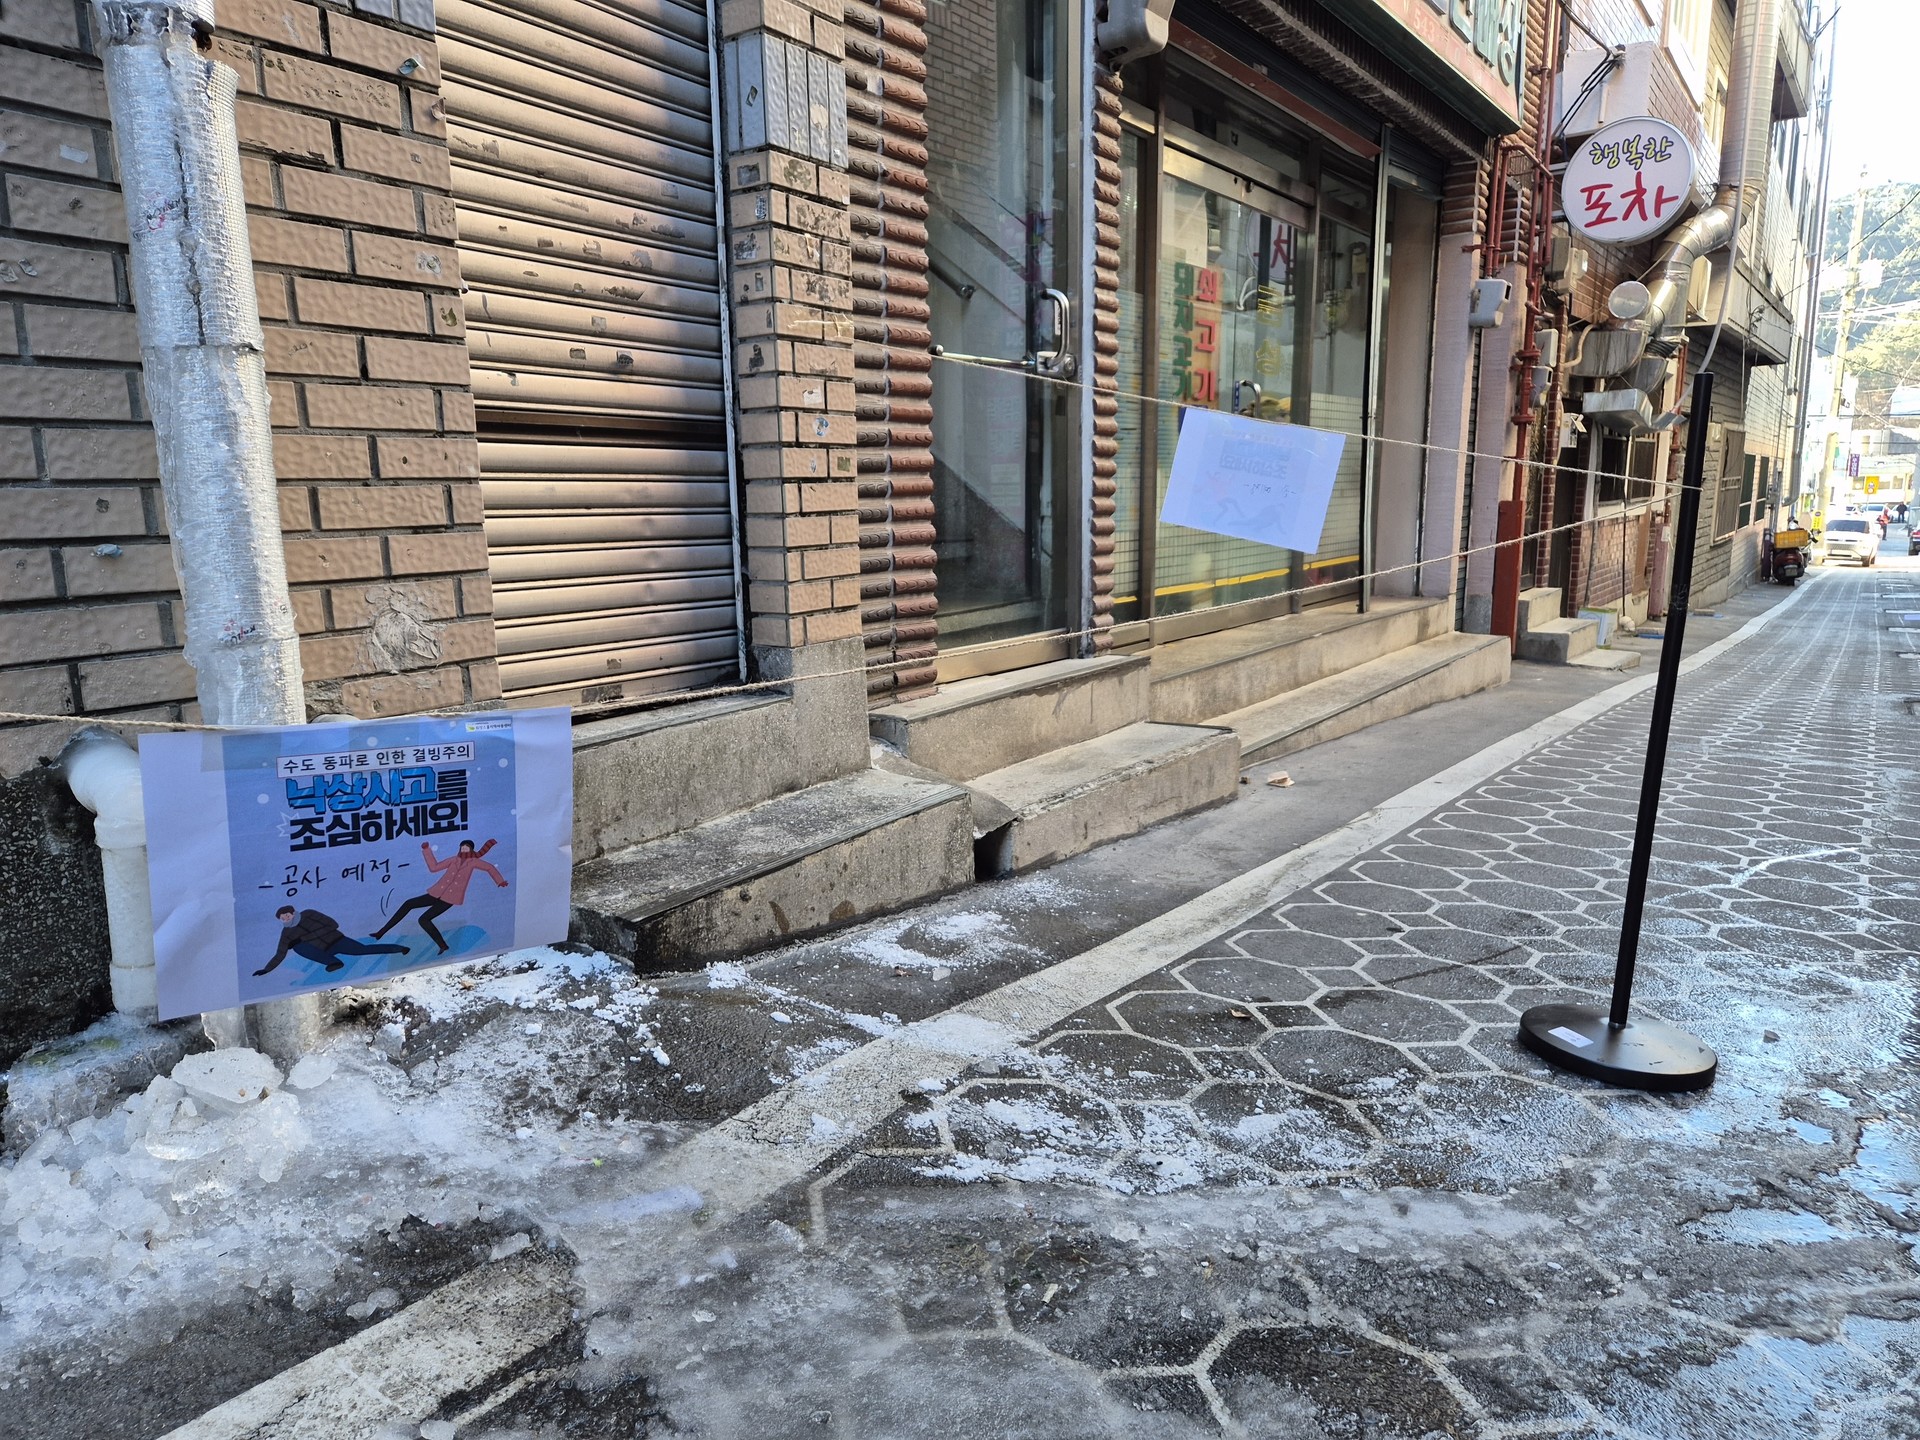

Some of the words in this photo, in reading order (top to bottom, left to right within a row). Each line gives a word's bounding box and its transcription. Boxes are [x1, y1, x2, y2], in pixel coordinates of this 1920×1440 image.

[1589, 134, 1674, 170] 행복한
[1580, 171, 1679, 228] 포차
[283, 759, 316, 774] 수도
[322, 754, 370, 771] 동파로
[376, 749, 406, 766] 인한
[413, 744, 470, 763] 결빙주의
[285, 766, 468, 815] 낙상사고를
[289, 800, 469, 852] 조심하세요!
